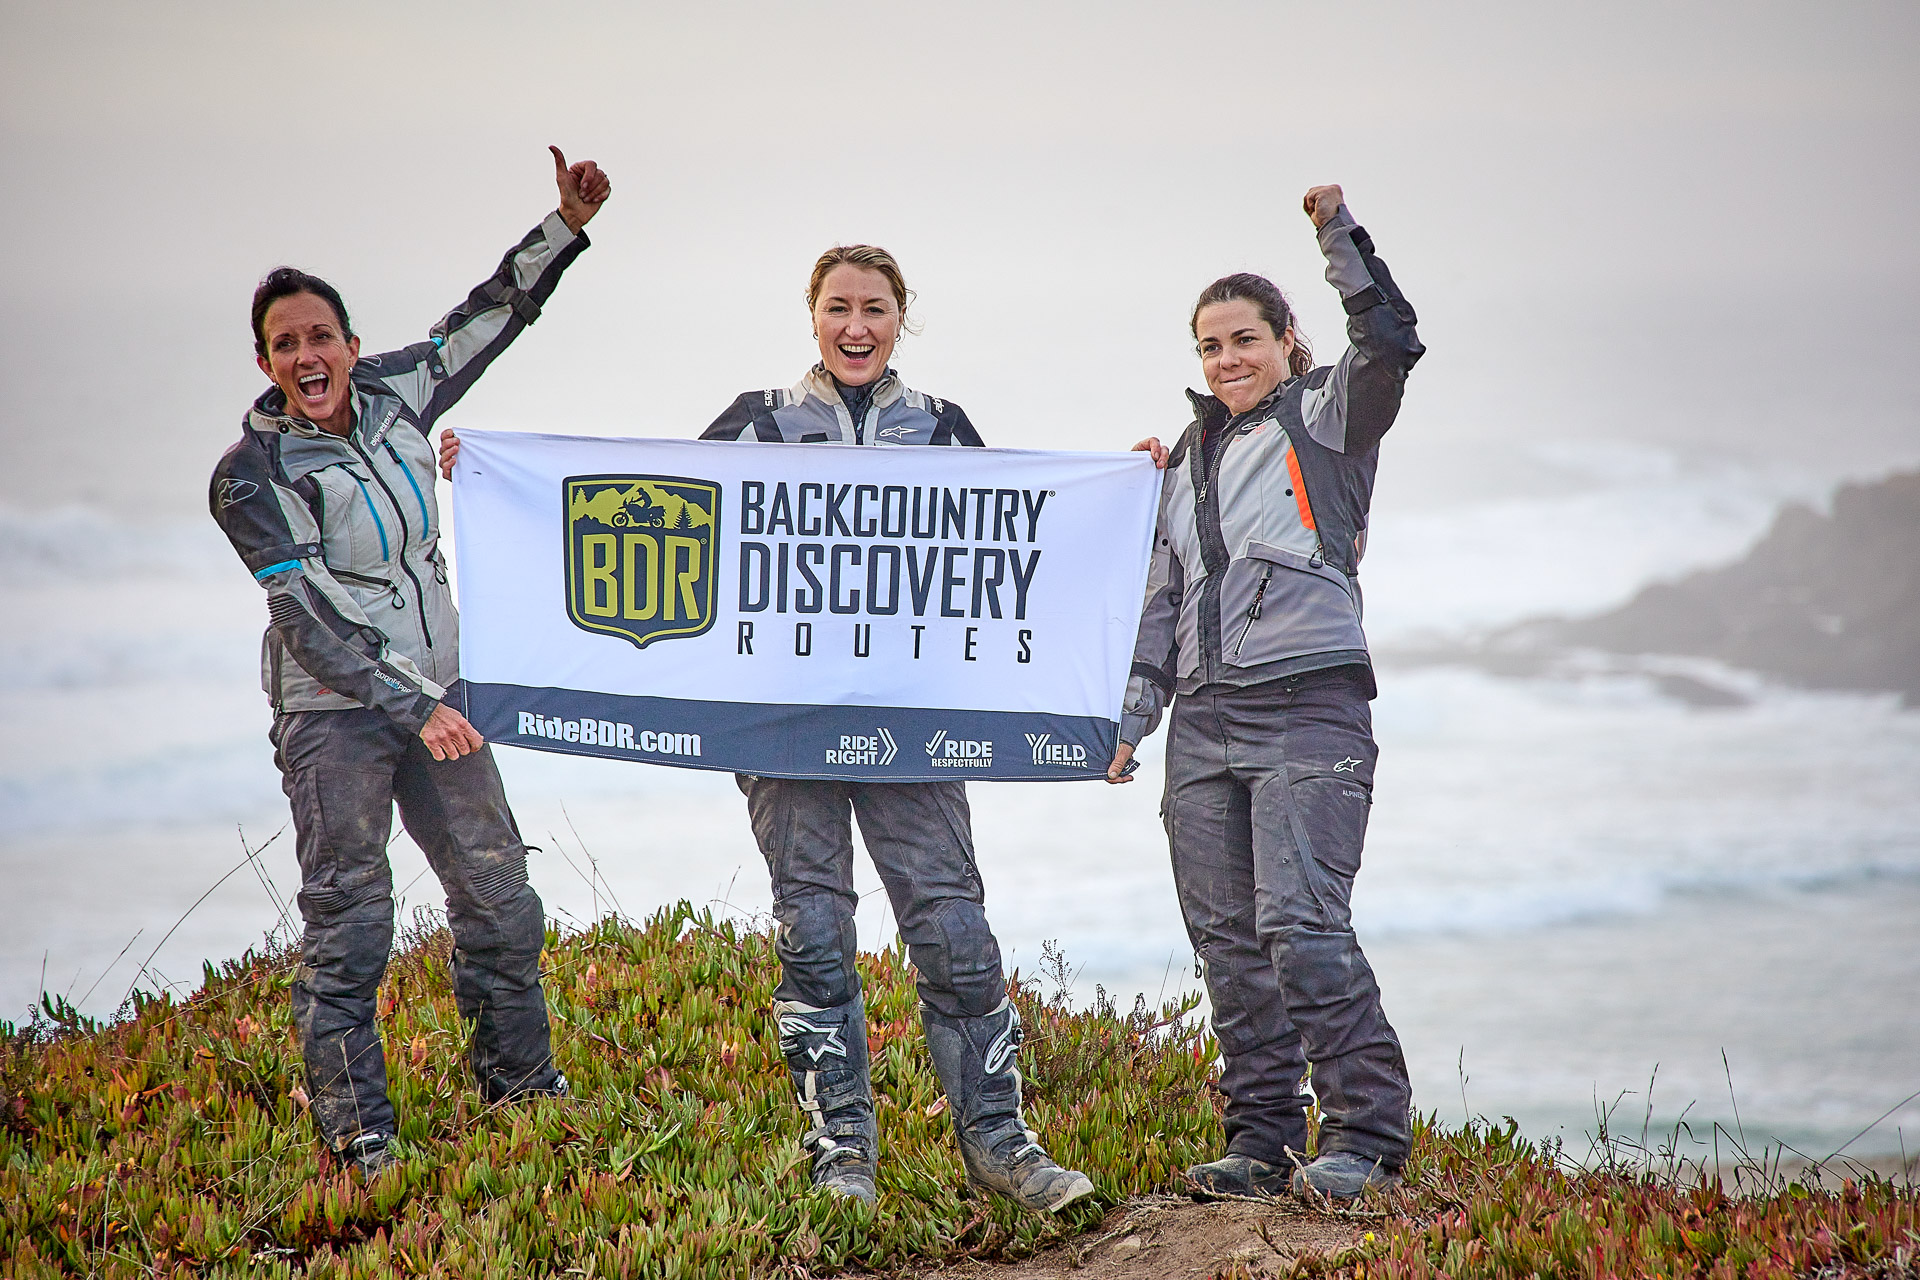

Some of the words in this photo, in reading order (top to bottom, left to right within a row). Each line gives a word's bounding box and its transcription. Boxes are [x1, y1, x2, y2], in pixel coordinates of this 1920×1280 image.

[738, 542, 1042, 621] DISCOVERY
[738, 620, 1032, 664] ROUTES
[518, 711, 701, 757] RideBDR.com
[839, 735, 878, 751] RIDE
[825, 750, 878, 765] RIGHT
[944, 739, 993, 758] RIDE
[1023, 733, 1087, 762] YIELD
[931, 757, 993, 768] RESPECTFULLY
